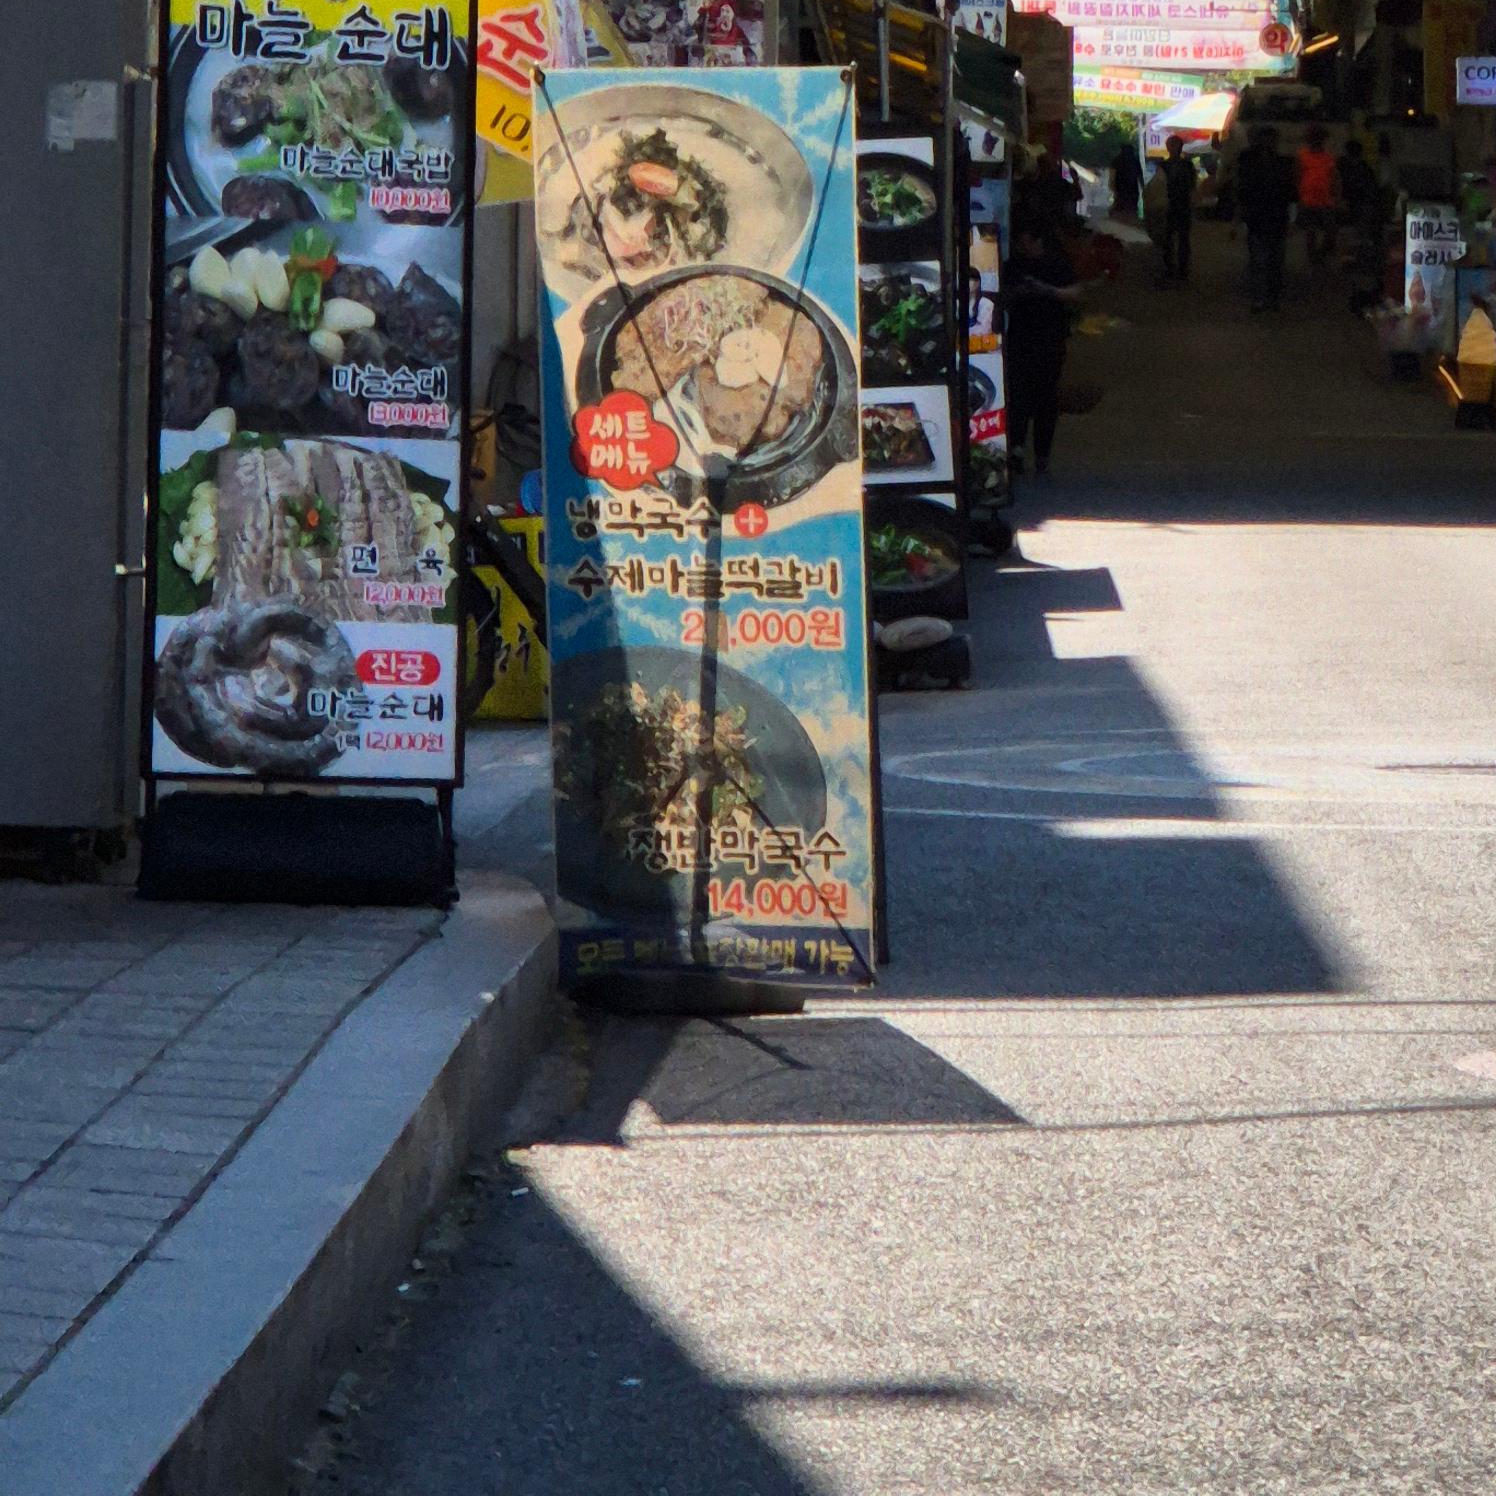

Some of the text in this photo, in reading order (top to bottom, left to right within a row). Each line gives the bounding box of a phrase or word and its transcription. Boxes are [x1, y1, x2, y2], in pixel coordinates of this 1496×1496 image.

[281, 145, 454, 182] 마늘순대국밥
[333, 364, 448, 400] 마늘순대
[588, 411, 651, 441] 세트
[589, 443, 651, 476] 메뉴
[568, 496, 722, 542] 냉막국수
[567, 555, 842, 601] 수제마늘떡갈비
[371, 651, 425, 681] 진공
[307, 688, 444, 723] 마늘순대
[628, 826, 848, 873] 쟁반막국수
[707, 879, 849, 918] 14,000원
[803, 937, 855, 976] 가능
